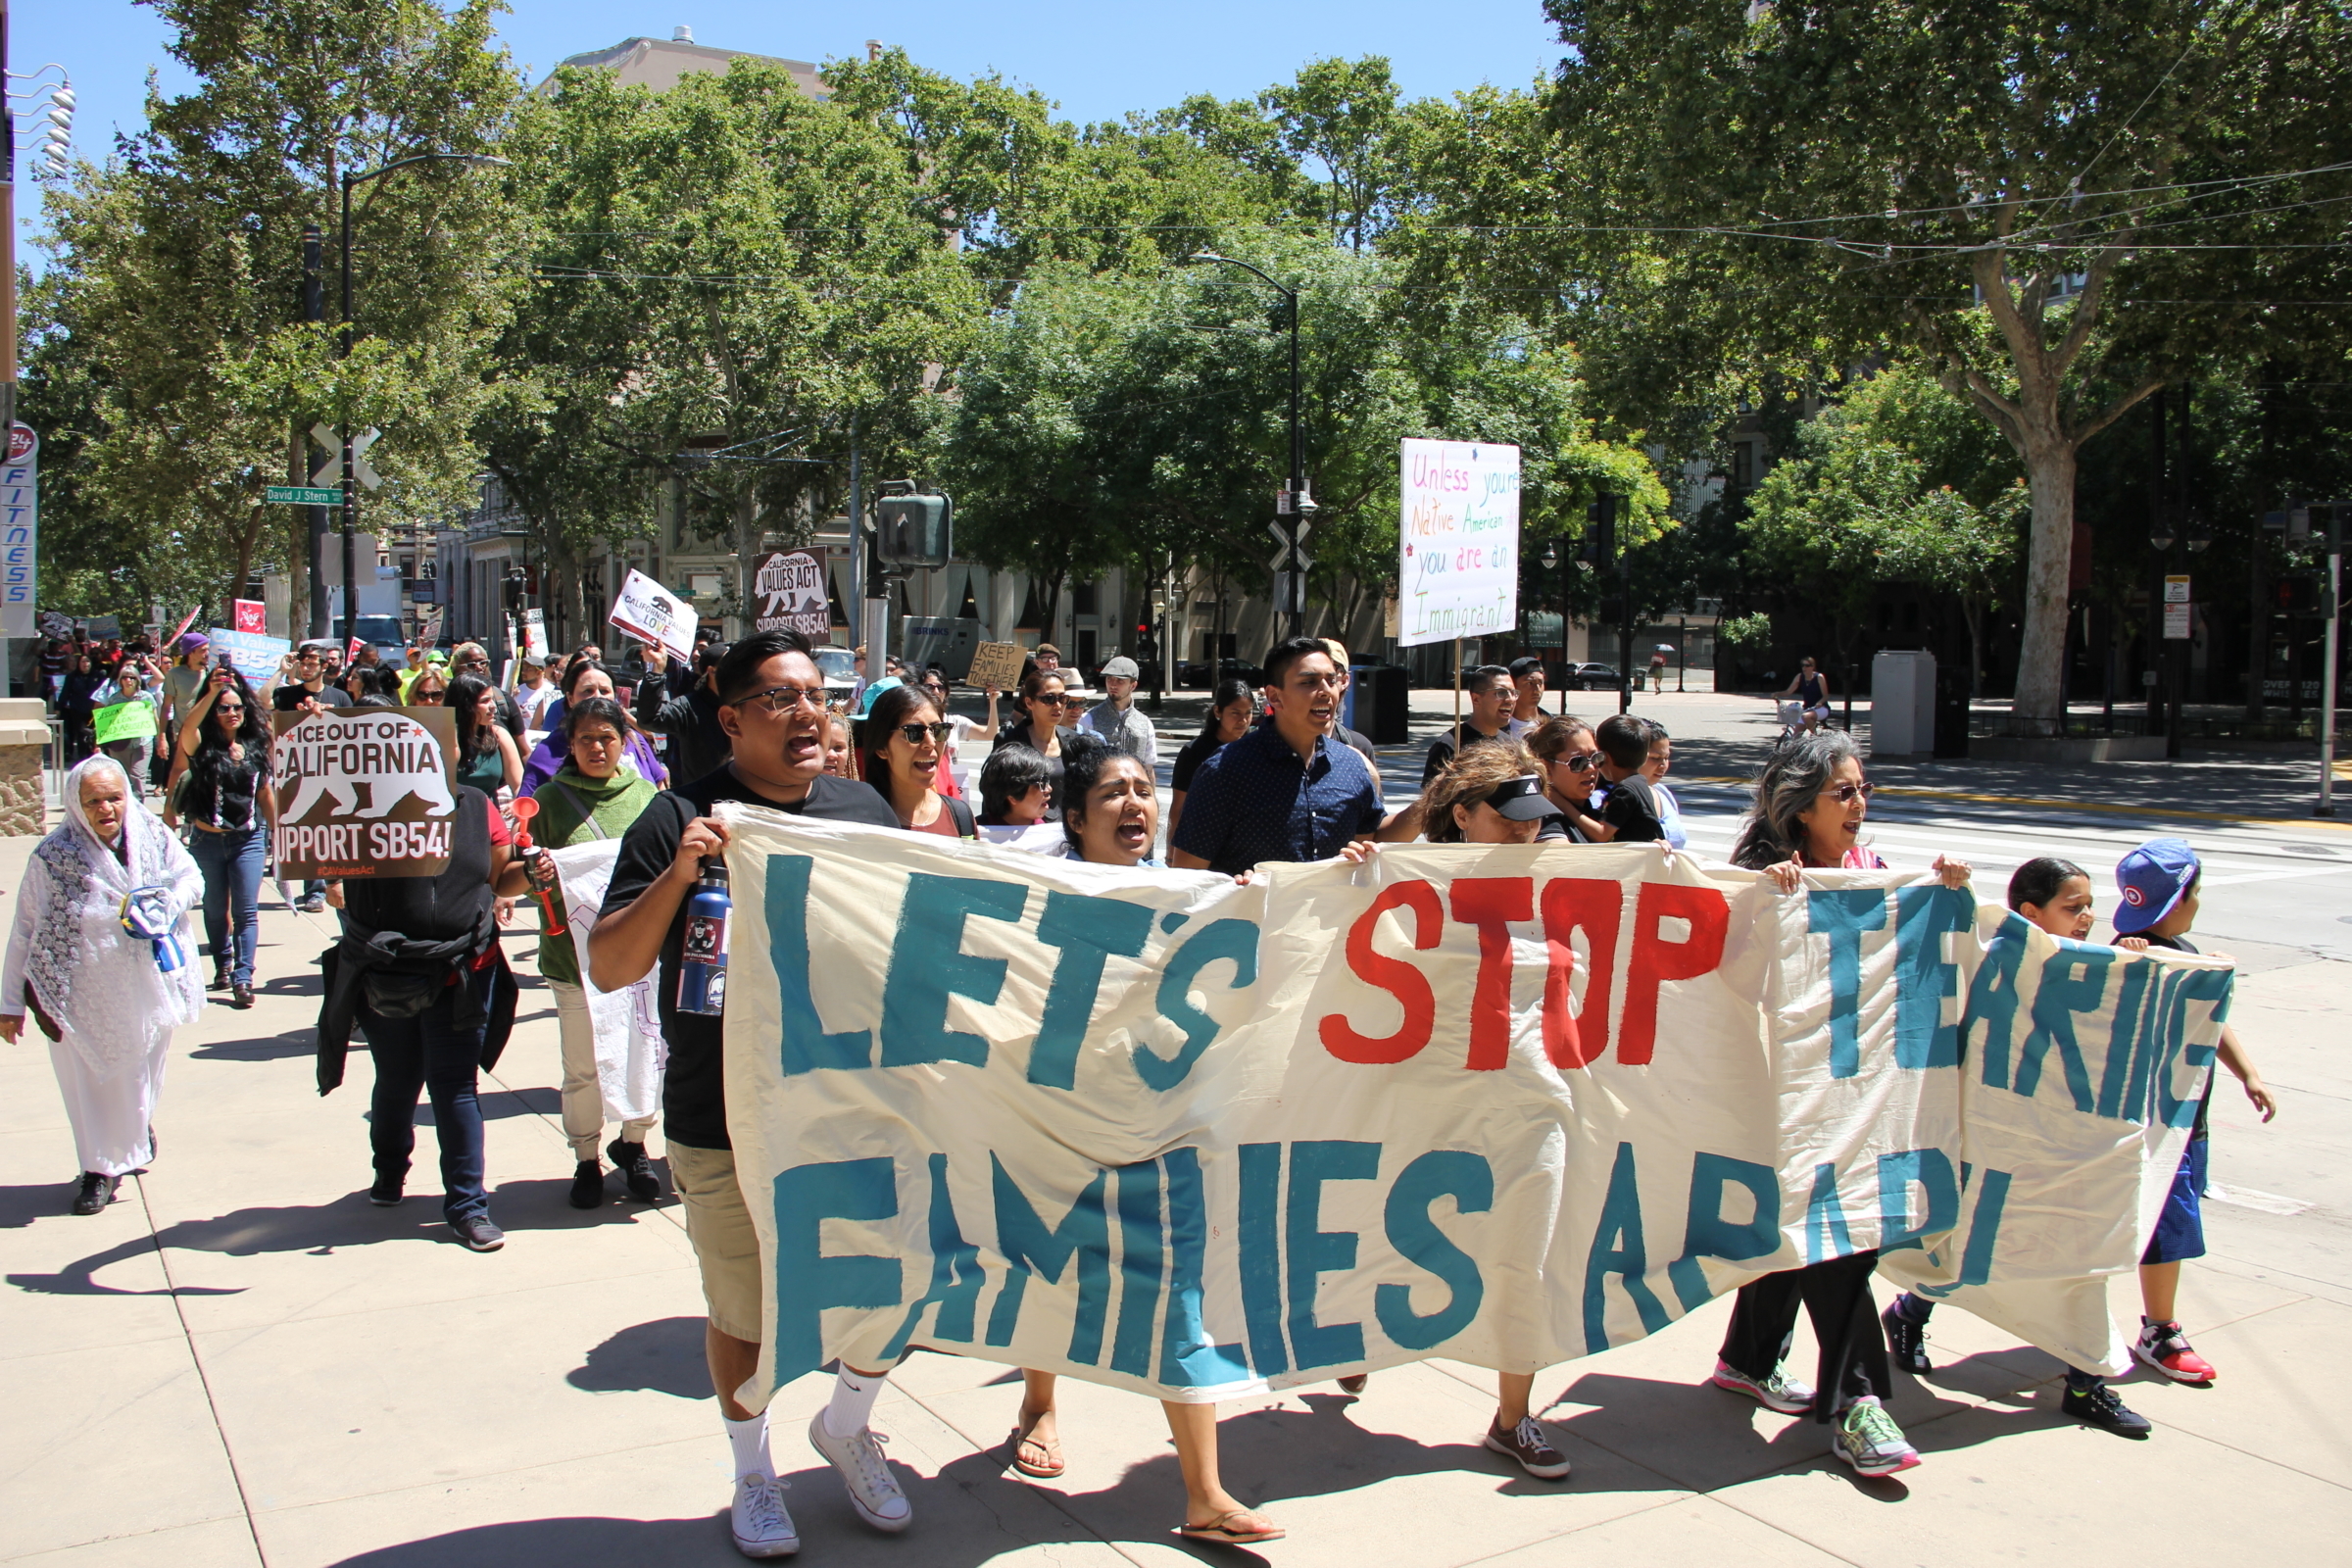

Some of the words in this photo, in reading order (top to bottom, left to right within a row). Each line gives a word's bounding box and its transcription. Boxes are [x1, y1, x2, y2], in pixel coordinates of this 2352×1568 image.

[1413, 449, 1469, 492] Unless
[1480, 461, 1519, 508] you're
[268, 489, 293, 501] David
[295, 490, 301, 501] J
[304, 490, 328, 502] Stern
[1411, 494, 1454, 536] Native
[1462, 504, 1503, 534] American
[6, 469, 28, 602] FITNESS
[768, 557, 808, 568] CALIFORNIA
[1414, 552, 1447, 594] you
[1456, 546, 1482, 571] are
[1492, 544, 1507, 568] an
[761, 566, 794, 593] VALUES
[796, 564, 817, 589] ACT
[624, 595, 667, 624] CALIFORNIA
[667, 618, 691, 639] VALUES
[643, 613, 670, 637] LOVE
[796, 612, 829, 635] SB54!
[1411, 587, 1507, 638] Immigrant
[213, 631, 234, 645] CA
[239, 634, 287, 653] Values
[916, 627, 950, 636] BRINKS
[209, 644, 283, 670] SB54
[978, 643, 1015, 661] KEEP
[972, 658, 1016, 676] FAMILIES
[970, 670, 1015, 690] TOGETHER
[2301, 681, 2321, 690] 120
[297, 725, 324, 743] ICE
[327, 723, 373, 741] OUT
[377, 722, 410, 740] OF
[275, 742, 439, 778] CALIFORNIA
[274, 823, 364, 862] UPPORT
[369, 821, 452, 859] SB54!
[317, 865, 375, 876] #CAValuesAct
[764, 854, 1261, 1092] LET'S
[1318, 877, 1730, 1072] STOP
[773, 1140, 1494, 1392] FAMILIES
